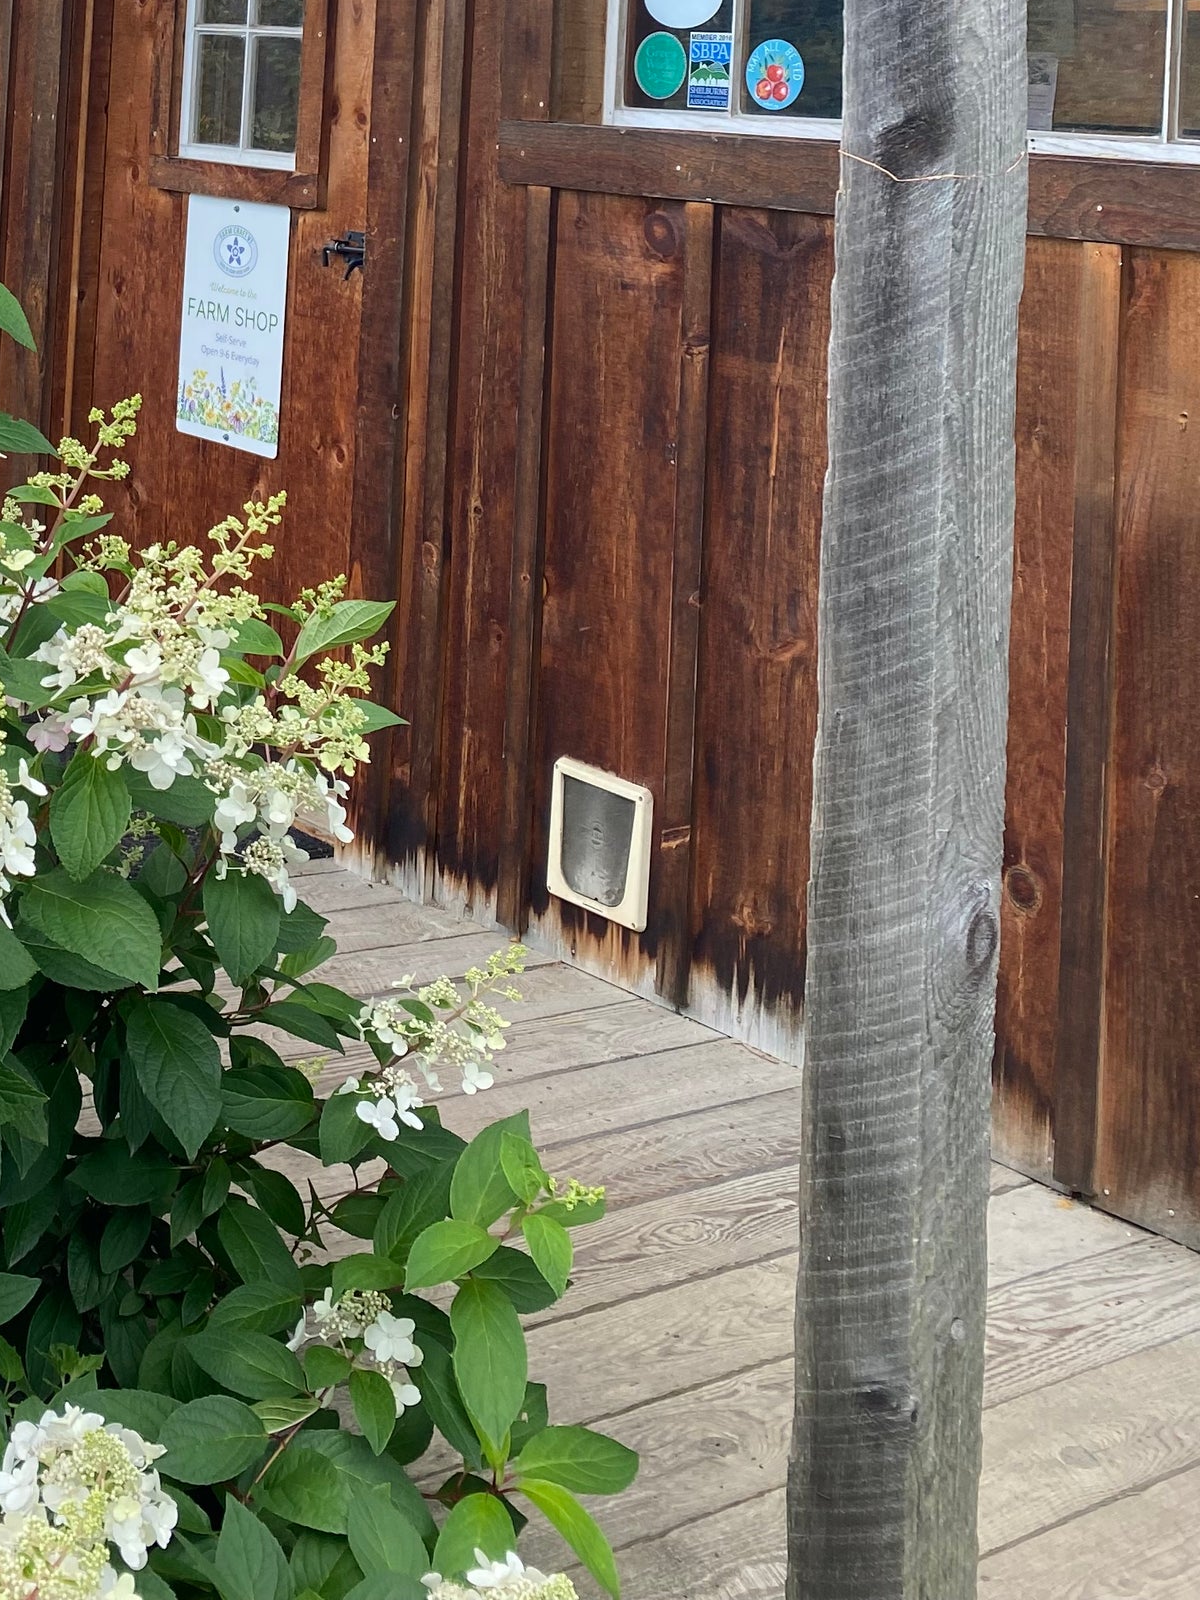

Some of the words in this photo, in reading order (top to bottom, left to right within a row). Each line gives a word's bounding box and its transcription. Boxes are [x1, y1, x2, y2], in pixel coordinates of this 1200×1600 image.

[692, 42, 729, 60] SBPA
[748, 51, 761, 73] MAY
[763, 42, 780, 55] ALL
[784, 47, 797, 61] BE
[792, 62, 802, 81] FED
[689, 86, 729, 96] SHELBURNE
[689, 98, 728, 107] ASSOCIATION
[210, 282, 239, 296] Welcome
[239, 288, 246, 298] to
[247, 288, 257, 300] the
[187, 297, 230, 324] FARM
[235, 306, 279, 333] SHOP
[215, 332, 247, 347] Self-Serve
[201, 344, 218, 356] Open
[219, 349, 230, 360] 9-6
[230, 352, 260, 367] Everyday
